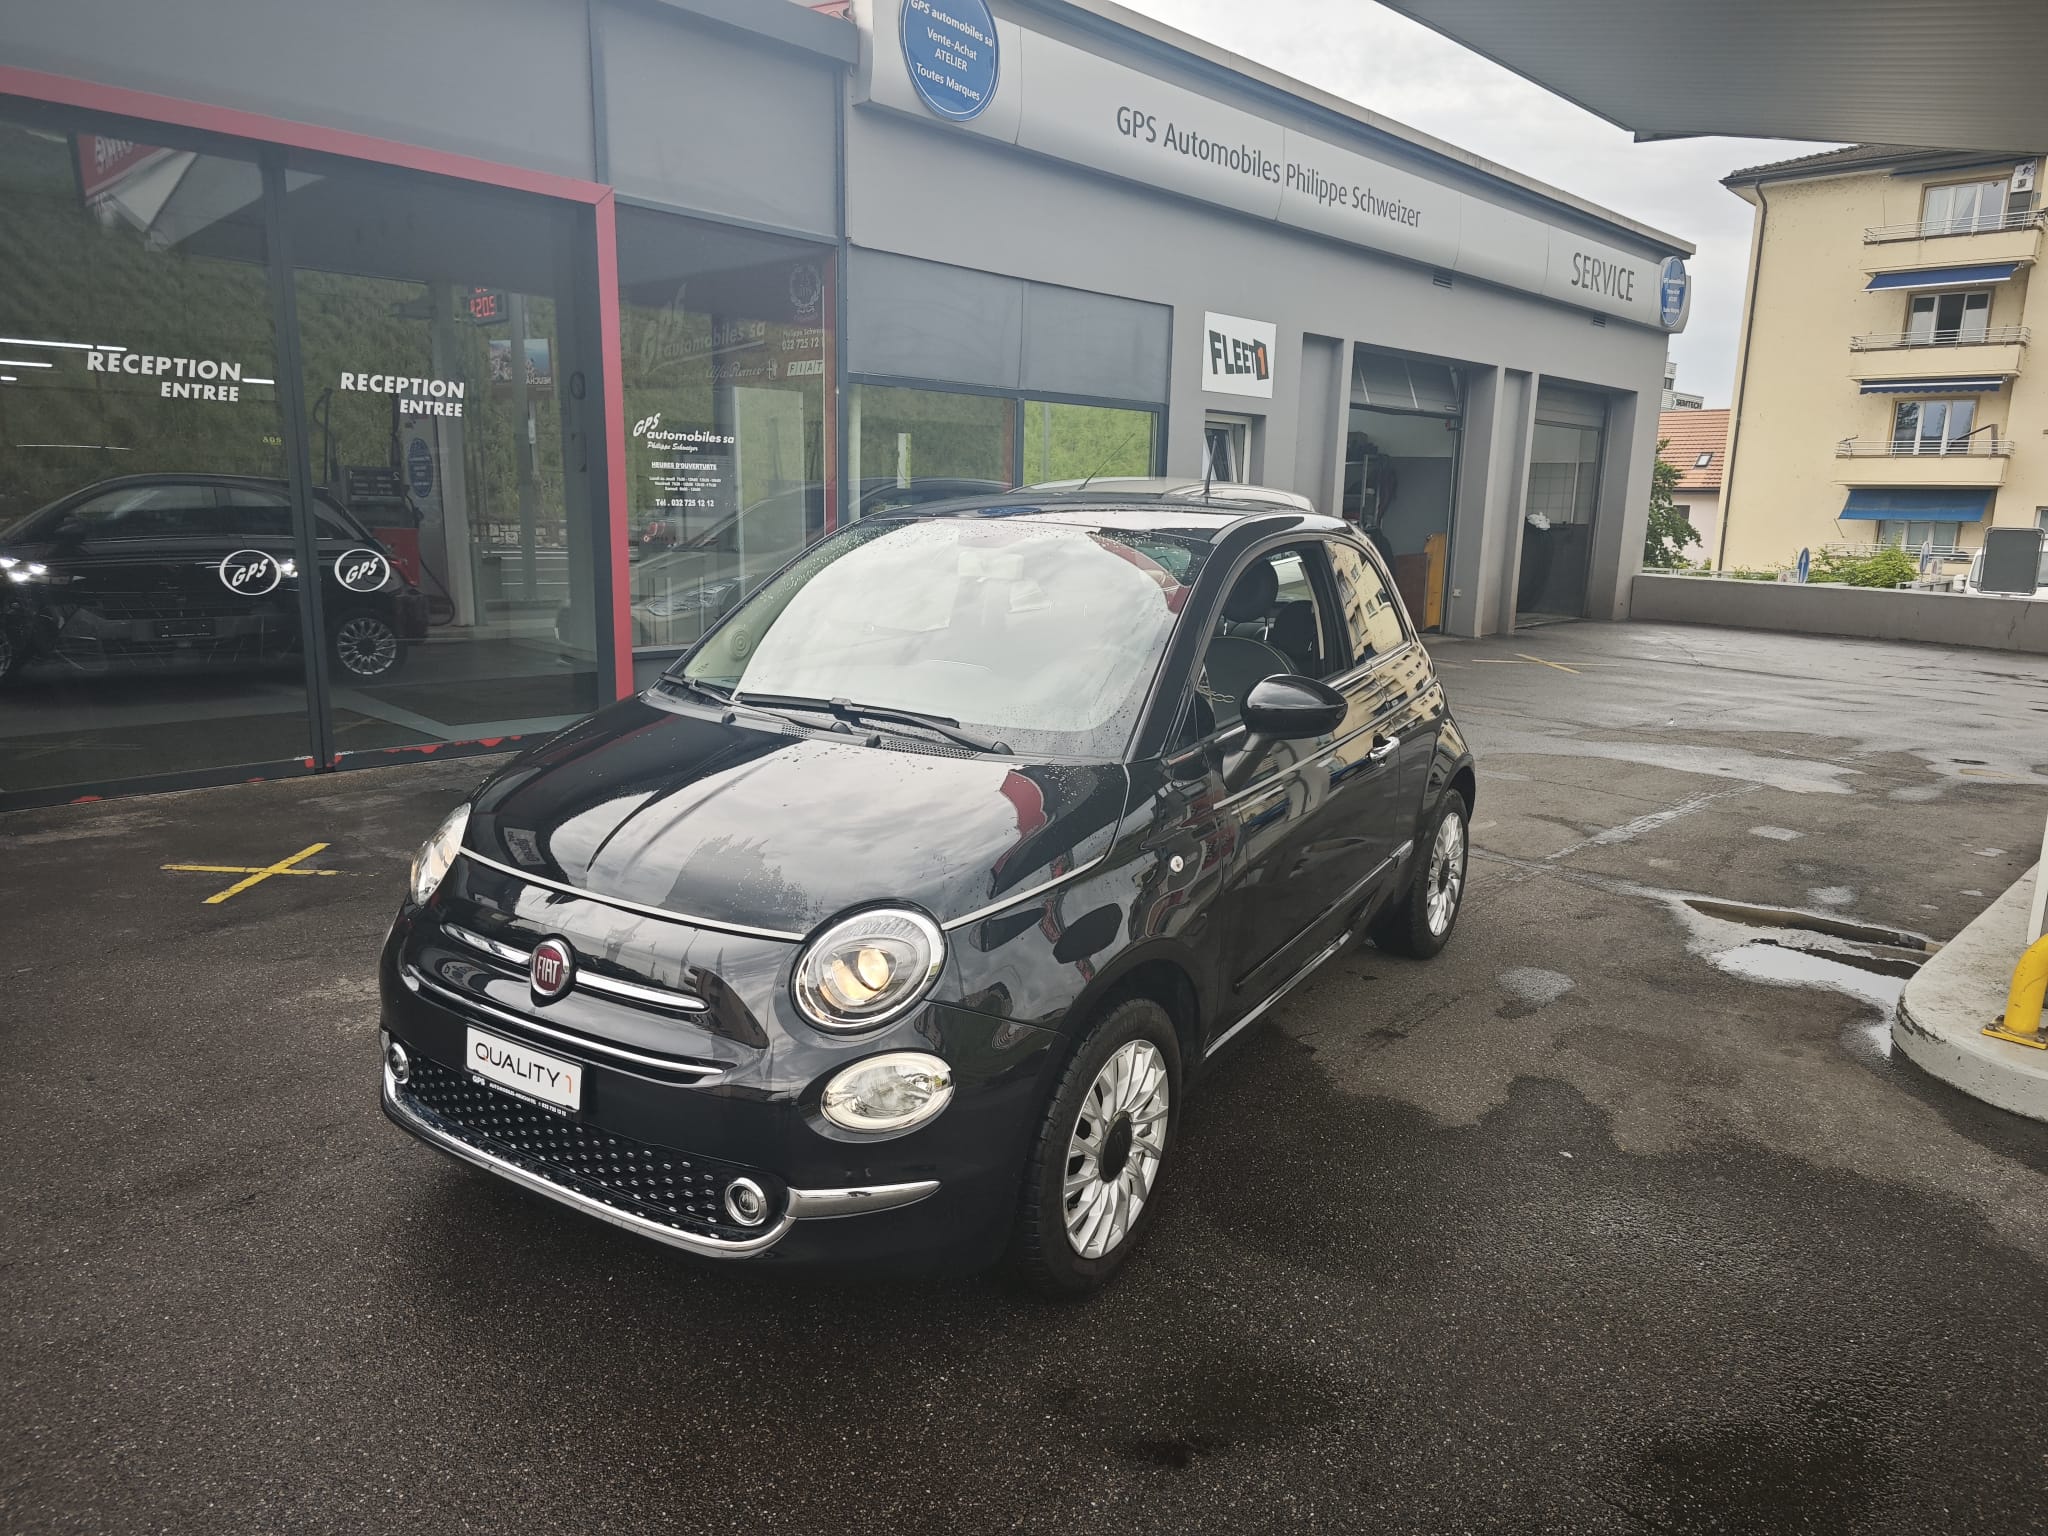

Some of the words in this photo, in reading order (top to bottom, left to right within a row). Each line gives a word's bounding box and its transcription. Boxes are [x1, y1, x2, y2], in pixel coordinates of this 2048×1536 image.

[911, 0, 930, 14] GPS
[931, 9, 984, 41] automobiles
[984, 36, 993, 47] sa
[927, 26, 977, 60] Vente-Achat
[934, 48, 968, 72] ATELIER
[916, 62, 945, 84] Toutes
[946, 76, 980, 101] Marques
[1116, 106, 1157, 143] GPS
[1163, 123, 1281, 184] Automobiles
[1286, 164, 1348, 207] Philippe
[1351, 186, 1421, 228] Schweizer
[1571, 252, 1635, 302] SERVICE
[87, 351, 241, 381] RECEPTION
[161, 381, 239, 402] ENTREE
[340, 372, 464, 399] RECEPTION
[399, 399, 463, 417] ENTREE
[633, 412, 661, 437] GPS
[647, 430, 721, 443] automobiles
[722, 436, 735, 444] sa
[671, 499, 683, 507] 032
[685, 499, 696, 507] 725
[697, 499, 705, 507] 12
[706, 499, 715, 507] 12
[232, 558, 269, 587] GPS
[345, 557, 379, 584] GPS
[536, 955, 560, 985] FIAT
[476, 1042, 560, 1088] QUALITY
